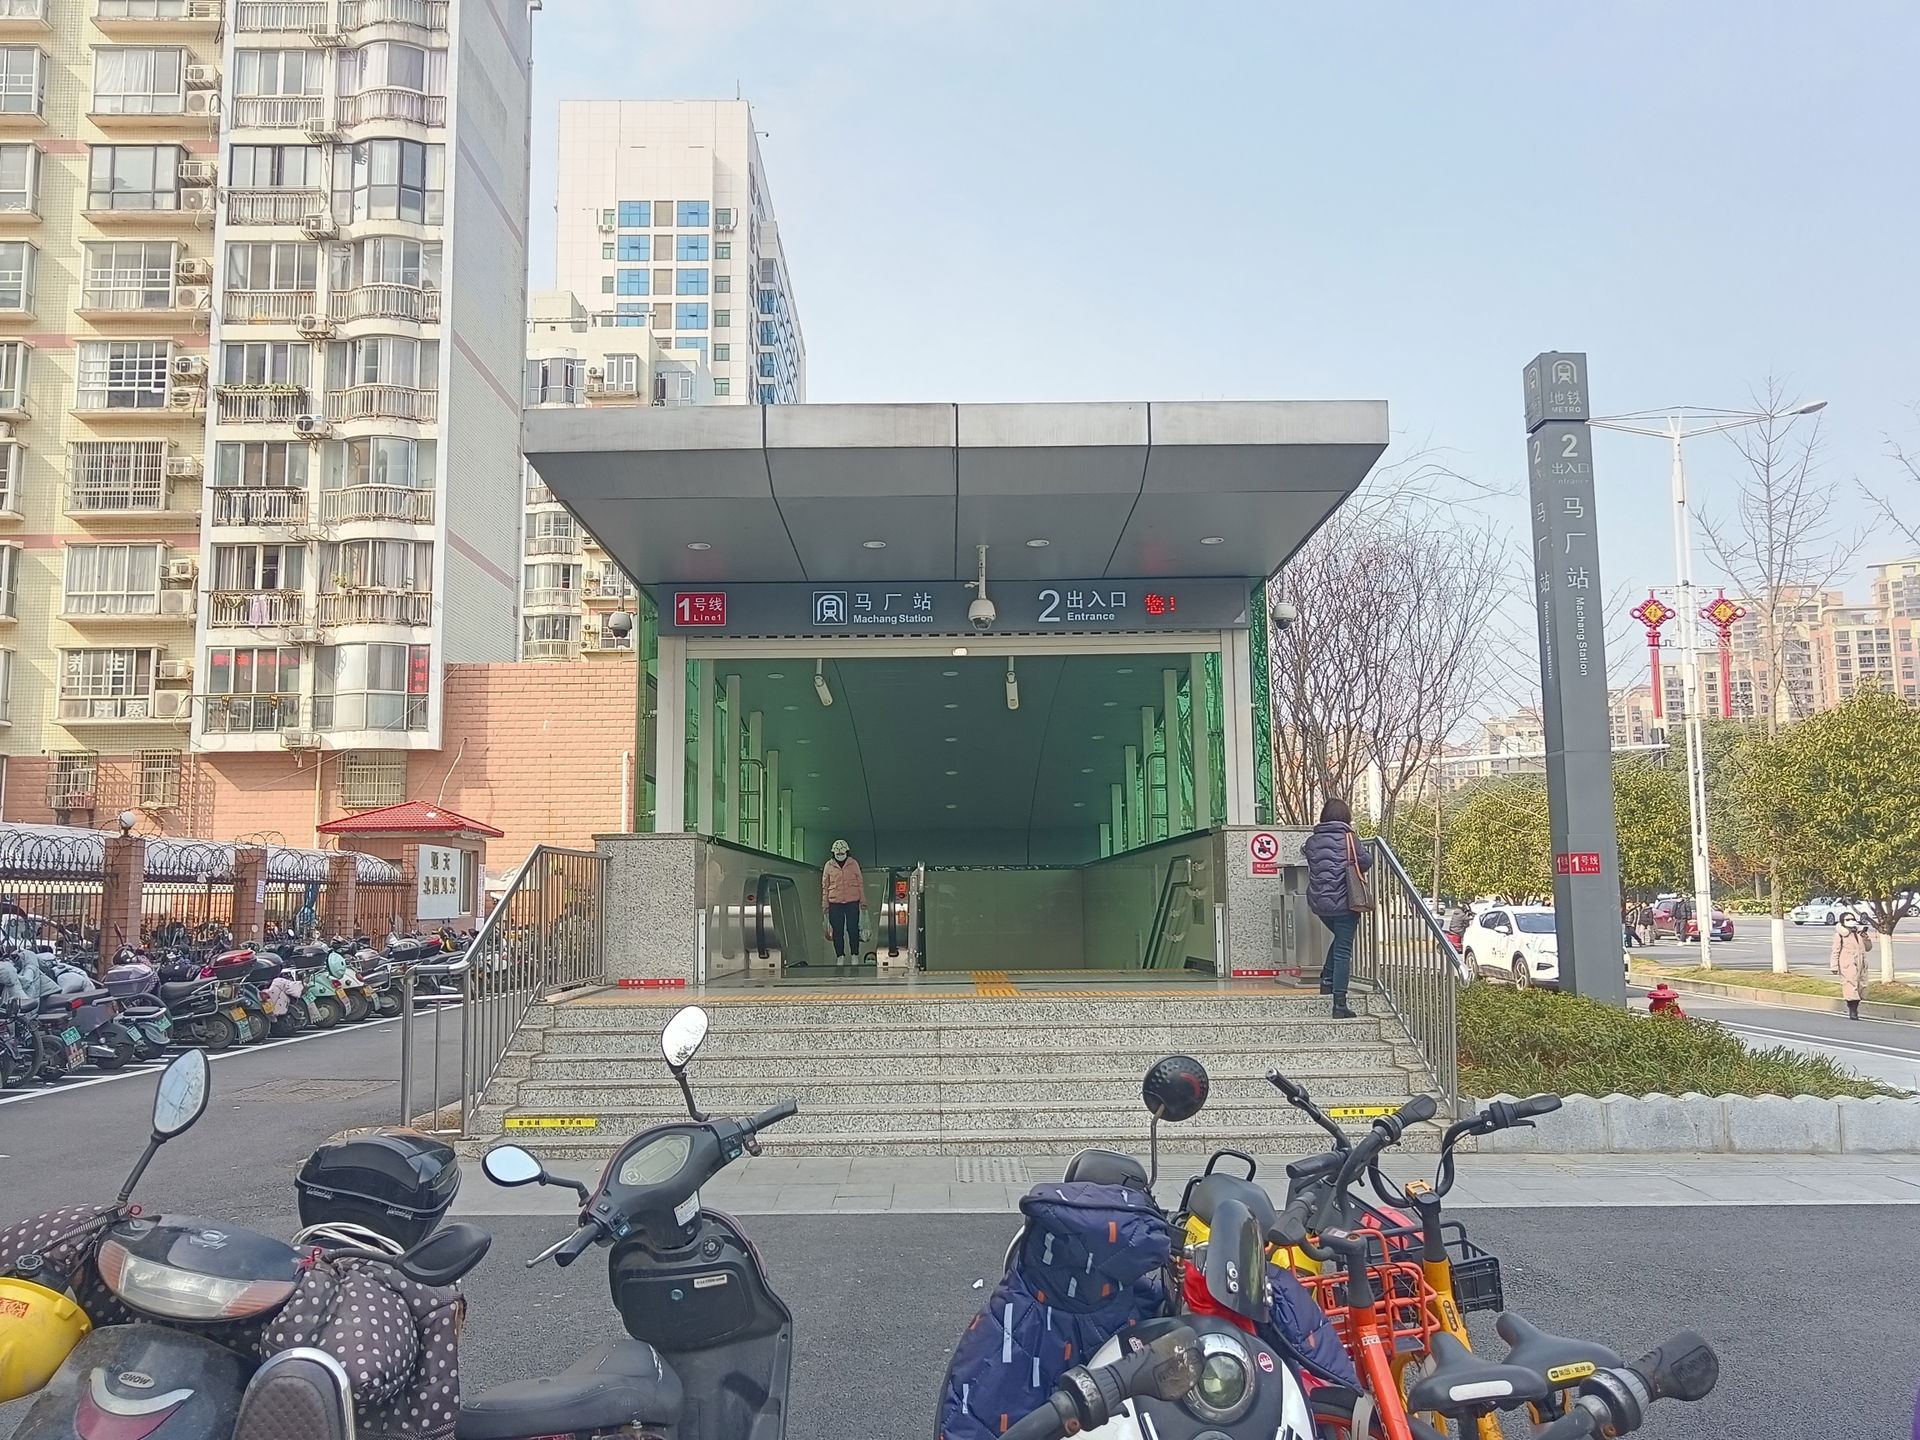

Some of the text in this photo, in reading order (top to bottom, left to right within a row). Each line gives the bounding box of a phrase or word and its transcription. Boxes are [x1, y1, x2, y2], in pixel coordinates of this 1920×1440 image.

[1550, 391, 1582, 405] 地铁
[1533, 440, 1542, 465] 2
[1561, 433, 1578, 458] 2
[1552, 462, 1589, 475] 出入口
[1536, 502, 1550, 593] 马厂站
[1562, 497, 1589, 590] 马厂站
[854, 592, 932, 611] 马厂站
[1038, 589, 1127, 622] 2 出入口
[693, 613, 722, 622] Line1
[853, 614, 933, 625] Machang Station
[1067, 611, 1115, 621] Entrance
[1575, 596, 1589, 676] Machang Station
[1571, 855, 1599, 872] 1号线
